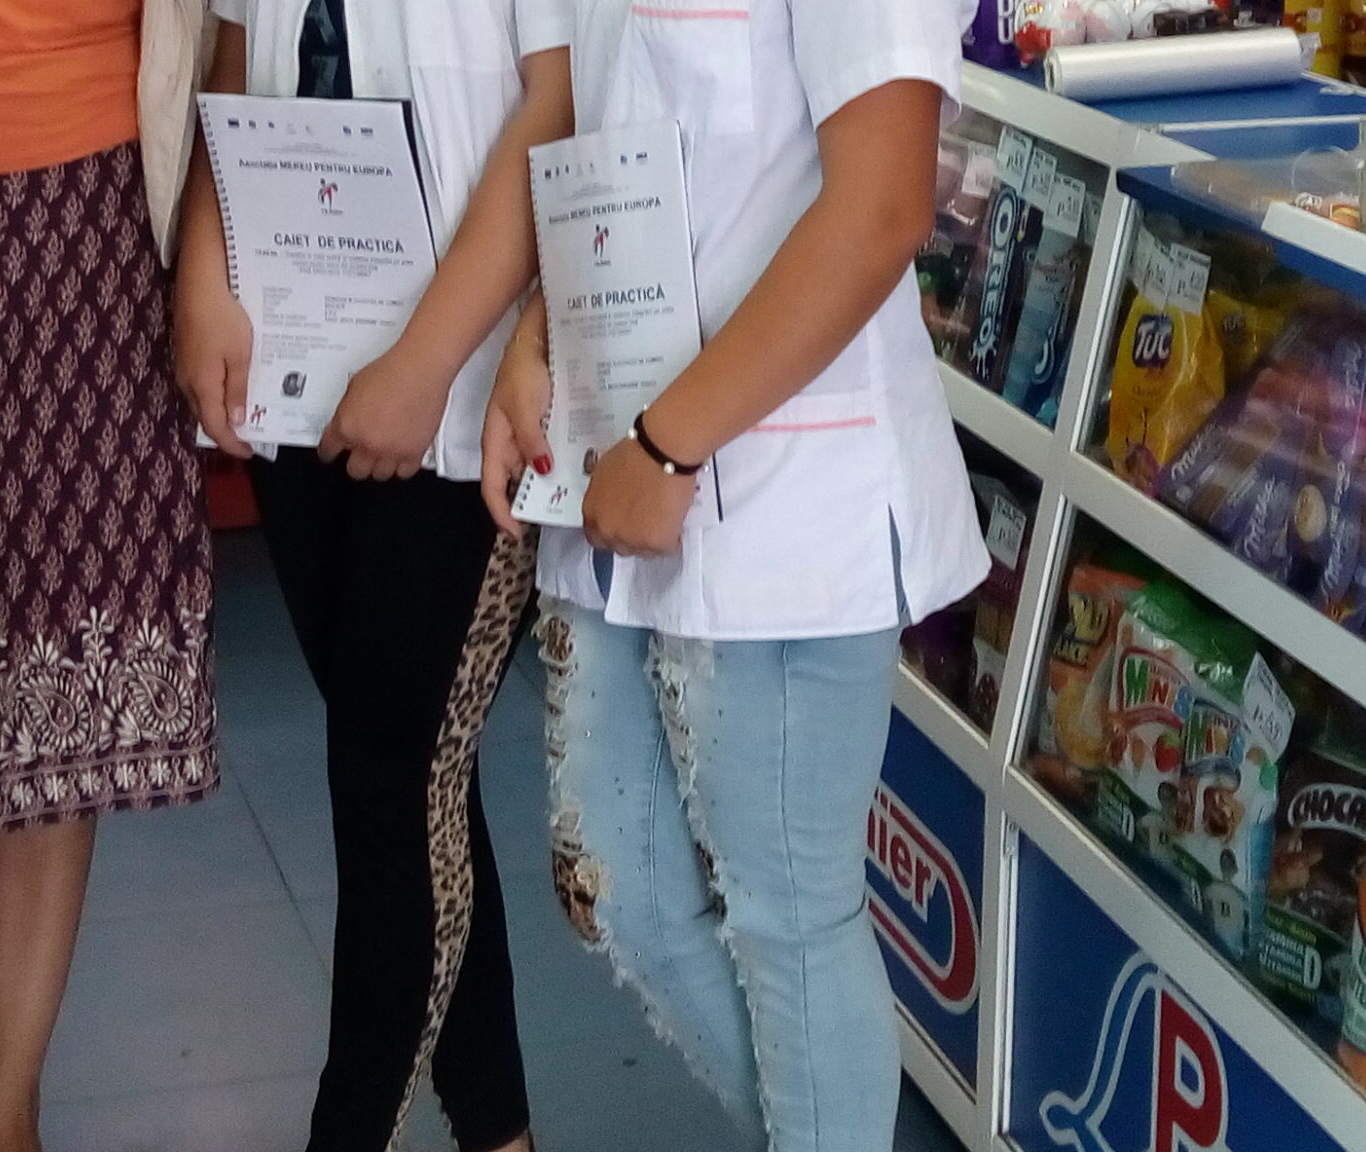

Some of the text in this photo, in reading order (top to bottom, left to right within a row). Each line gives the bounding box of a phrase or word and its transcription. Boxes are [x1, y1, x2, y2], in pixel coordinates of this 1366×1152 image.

[623, 196, 662, 211] EUROPA
[273, 232, 311, 248] CAIET
[317, 234, 335, 249] DE
[978, 195, 1015, 345] OREO
[590, 292, 605, 309] DE
[1134, 318, 1171, 362] TUC
